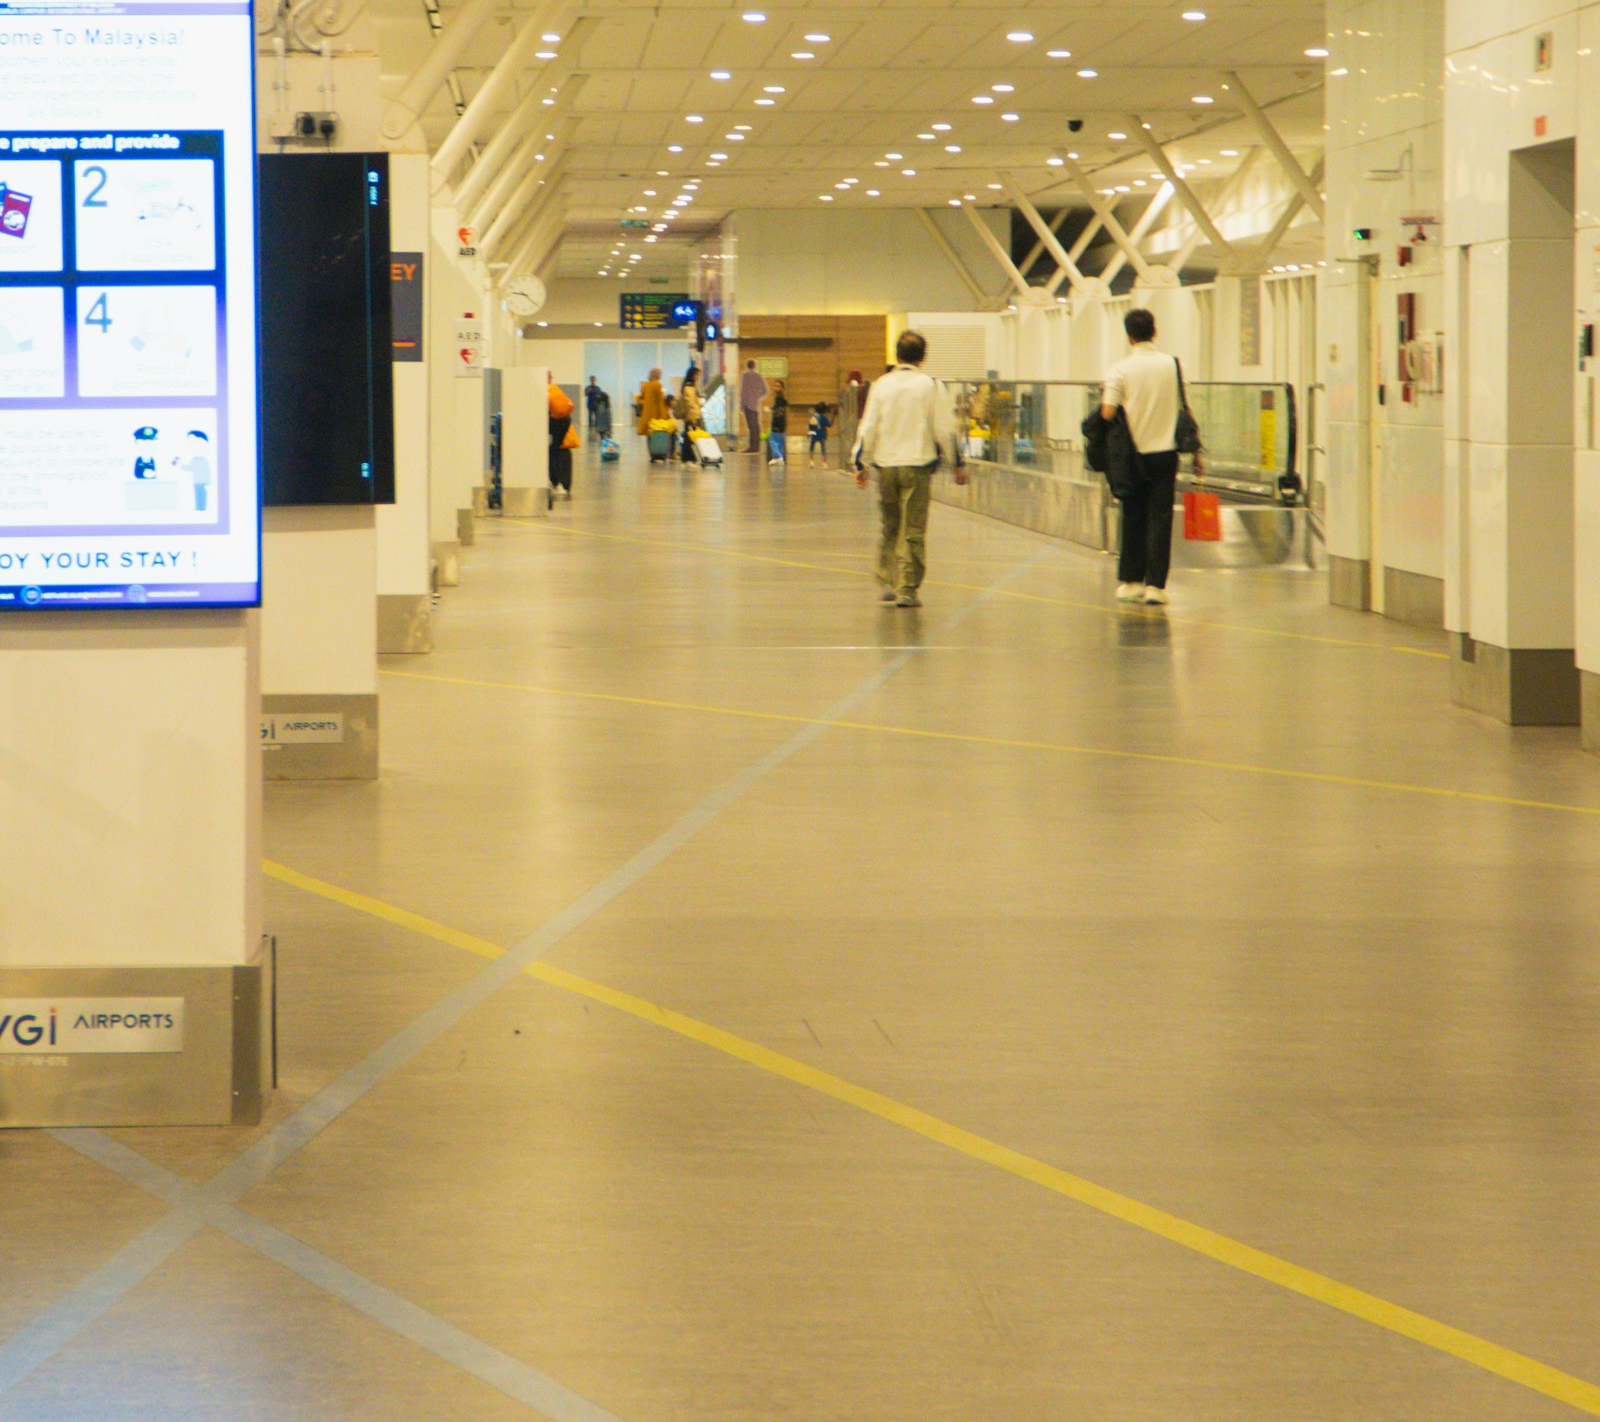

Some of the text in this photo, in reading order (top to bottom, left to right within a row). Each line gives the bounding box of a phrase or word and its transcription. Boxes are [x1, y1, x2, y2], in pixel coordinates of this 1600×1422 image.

[52, 28, 76, 46] To
[12, 136, 78, 153] prepare
[79, 134, 114, 150] and
[115, 133, 180, 152] provide
[81, 165, 108, 208] 2
[84, 291, 113, 334] 4
[40, 551, 111, 570] YOUR
[119, 550, 182, 569] STAY
[283, 721, 338, 731] AIRPORTS
[73, 1013, 174, 1029] AIRPORTS
